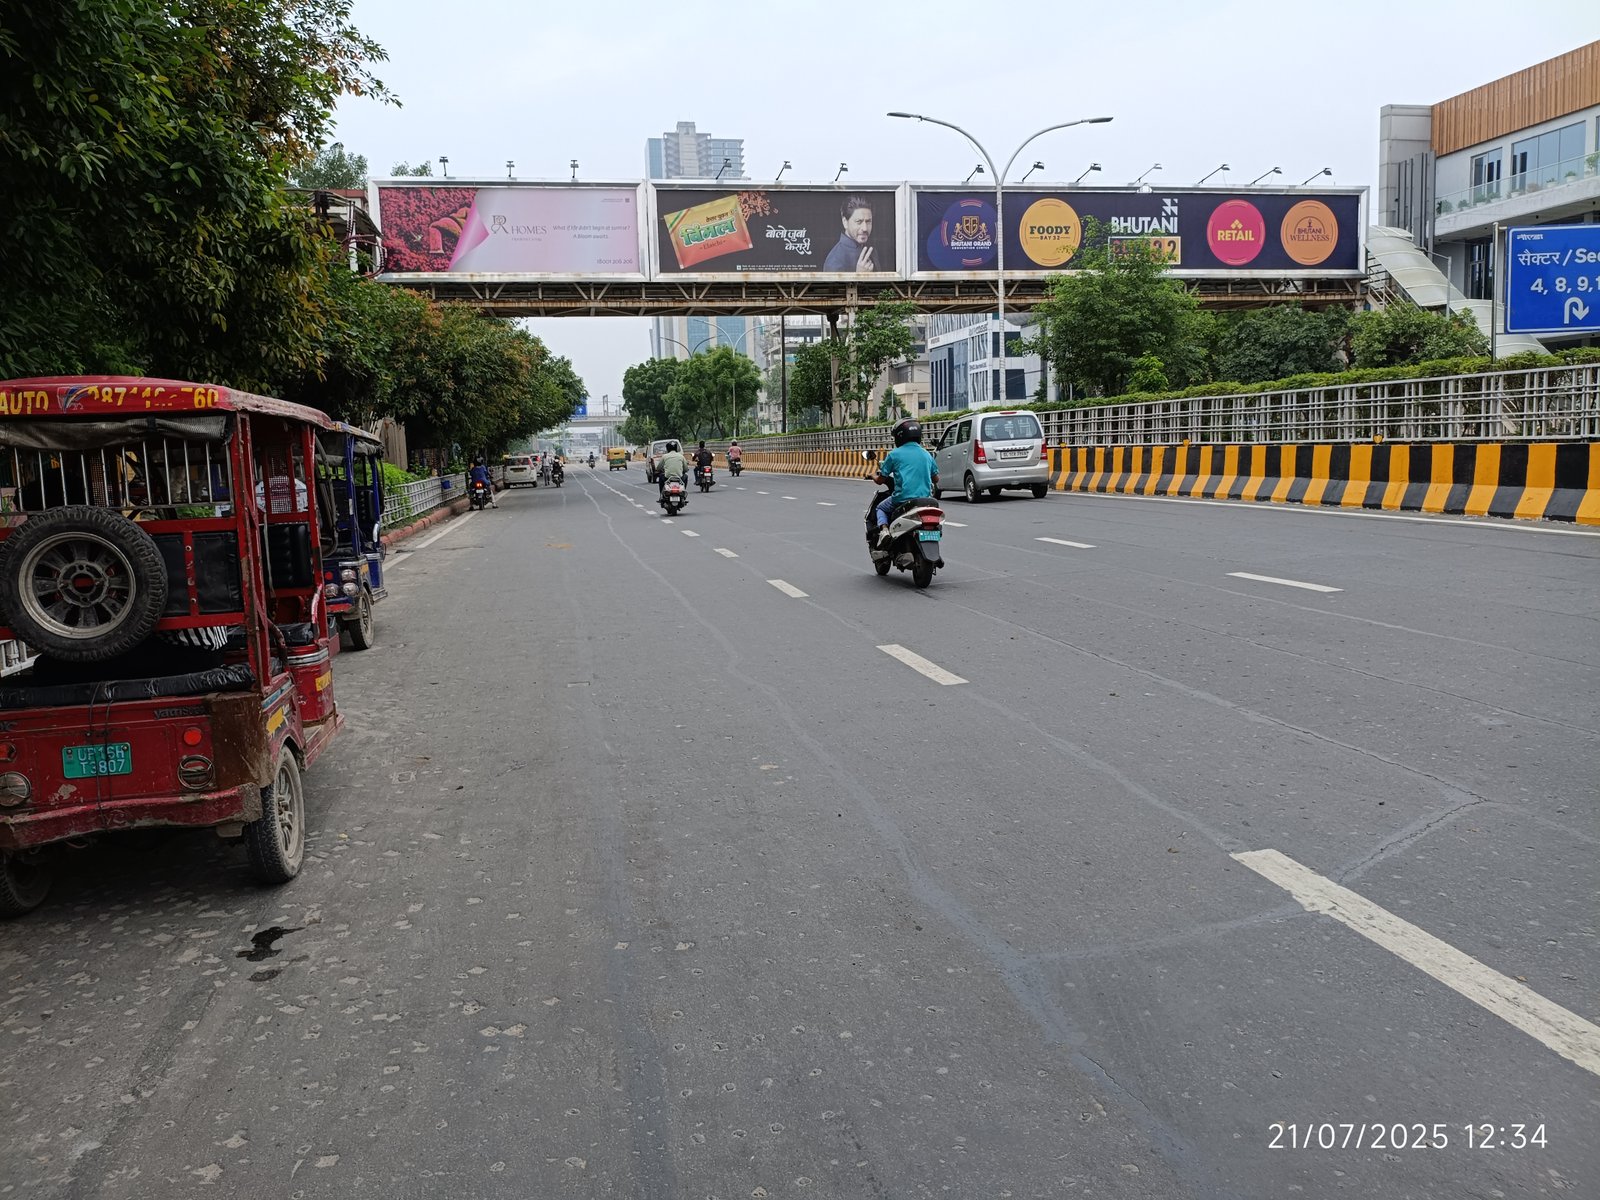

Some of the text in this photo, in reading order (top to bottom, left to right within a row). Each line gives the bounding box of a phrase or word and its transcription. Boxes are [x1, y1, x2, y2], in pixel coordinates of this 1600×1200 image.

[511, 225, 548, 235] HOMES
[1029, 225, 1071, 235] FOODY
[1111, 216, 1178, 234] BHUTANI
[765, 225, 787, 239] बोलो
[1217, 230, 1255, 241] RETAIL
[1290, 234, 1330, 242] WELLNESS
[783, 238, 812, 255] केसरी
[1517, 248, 1561, 266] सैक्टर
[1574, 248, 1600, 264] Se
